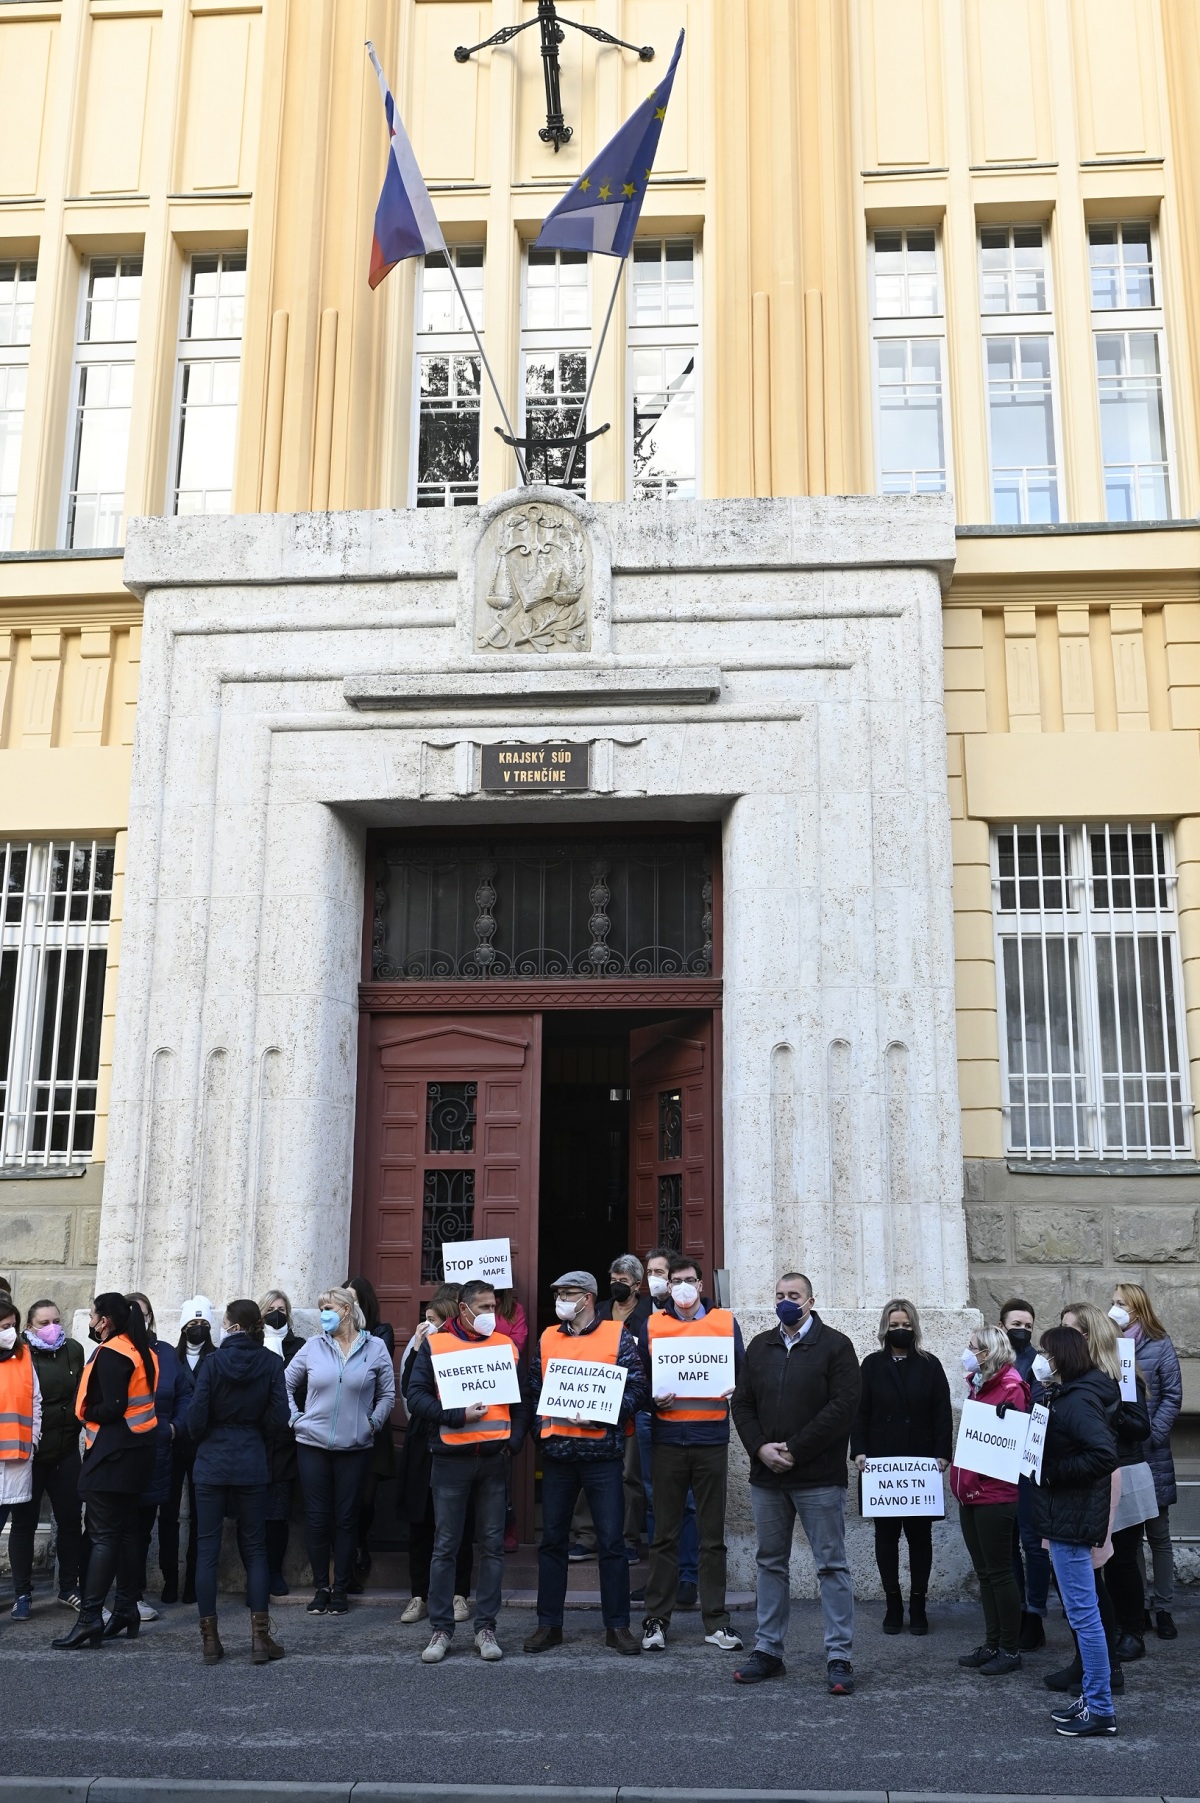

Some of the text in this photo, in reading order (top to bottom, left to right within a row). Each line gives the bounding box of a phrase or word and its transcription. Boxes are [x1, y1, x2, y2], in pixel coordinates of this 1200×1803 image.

[499, 749, 572, 764] KRAJSKÝ SÚD
[503, 767, 566, 782] V TRENČÍNE
[445, 1259, 474, 1271] STOP
[478, 1255, 508, 1264] SÚDNEJ
[482, 1267, 506, 1276] MAPE
[658, 1351, 728, 1364] STOP SÚDNEJ
[438, 1360, 513, 1378] NEBERTE NÁM
[548, 1362, 623, 1381] ŠPECIALIZÁCIA
[678, 1371, 710, 1381] MAPE
[461, 1378, 496, 1392] PRÁCU
[559, 1381, 607, 1394] NA KS TN
[546, 1395, 613, 1412] DÁVNO JE !!!
[965, 1428, 1017, 1451] HALOOOO!!!
[864, 1460, 938, 1473] ŠPECIALIZÁCIA
[878, 1479, 926, 1489] NA KS TN
[869, 1494, 936, 1506] DÁVNO JE !!!
